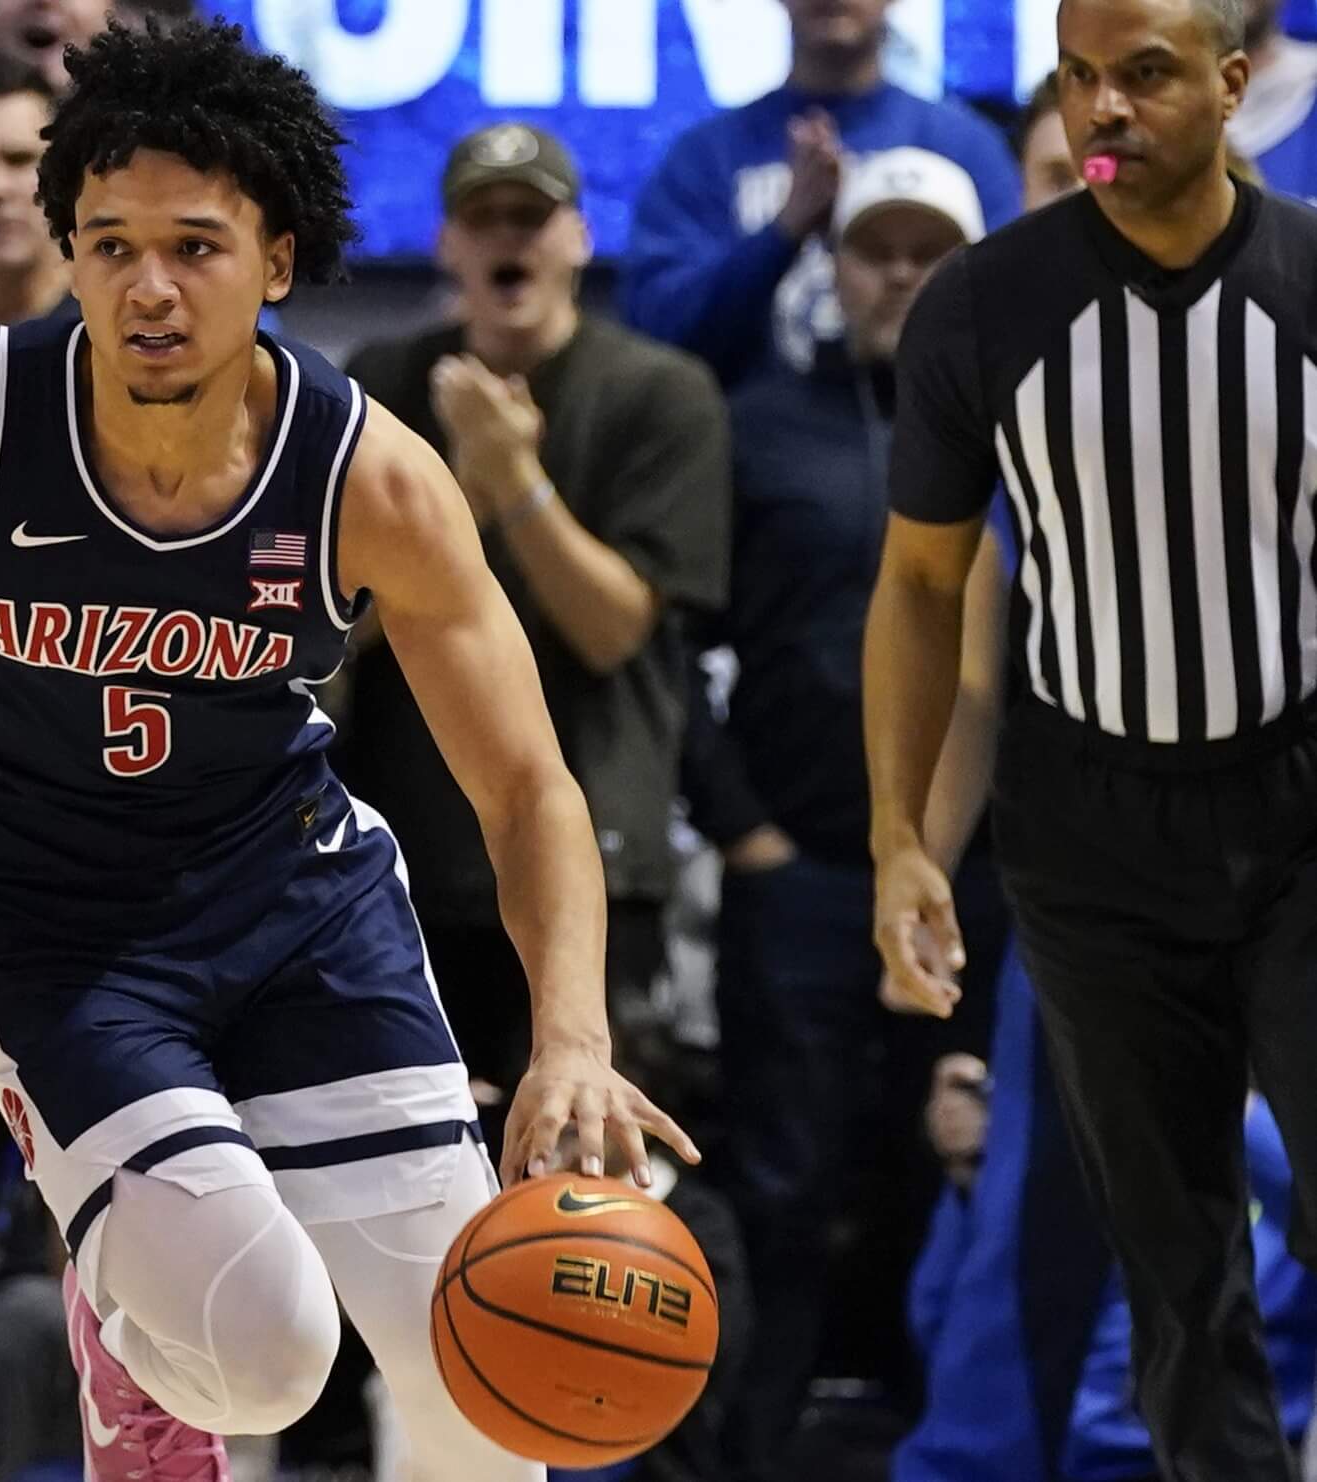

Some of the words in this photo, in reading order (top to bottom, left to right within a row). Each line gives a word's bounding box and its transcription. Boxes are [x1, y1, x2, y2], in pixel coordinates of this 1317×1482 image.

[249, 578, 302, 609] XII
[103, 685, 171, 777] 5
[552, 1255, 692, 1329] ELITE
